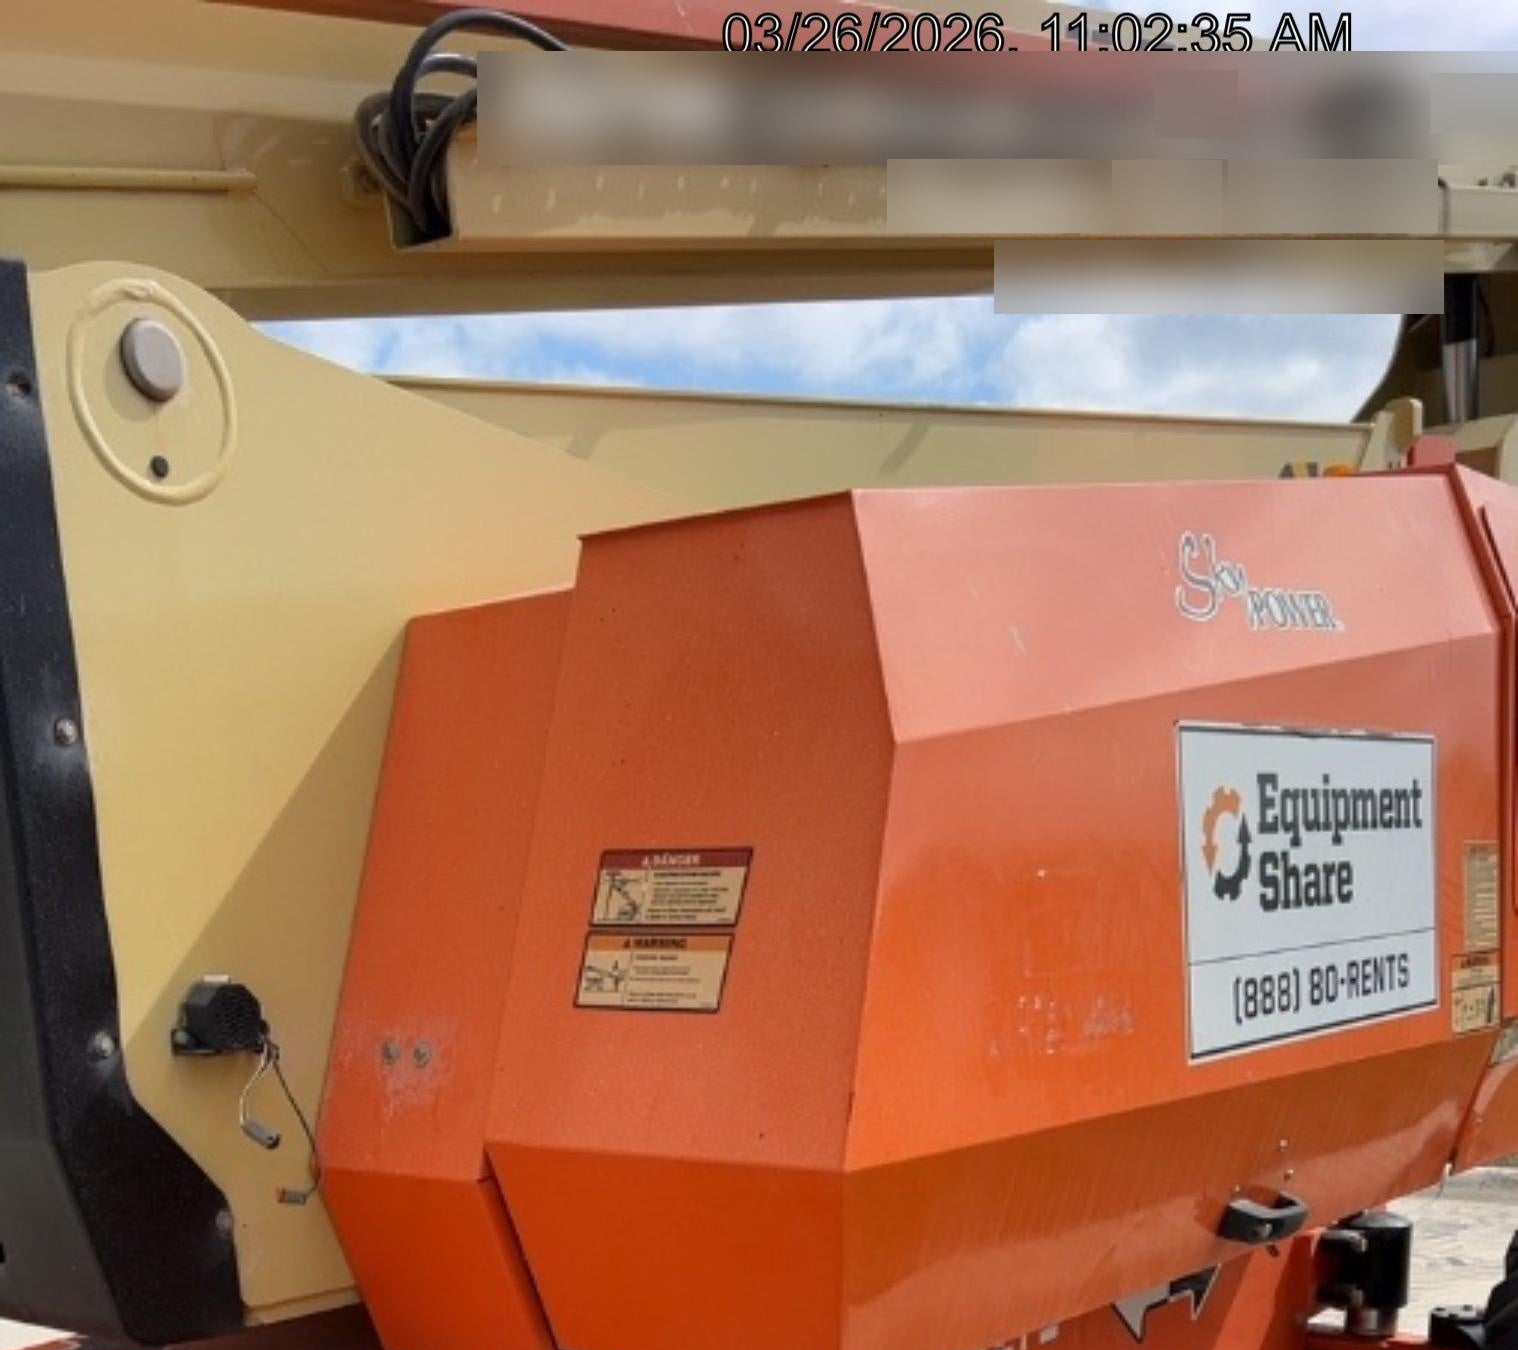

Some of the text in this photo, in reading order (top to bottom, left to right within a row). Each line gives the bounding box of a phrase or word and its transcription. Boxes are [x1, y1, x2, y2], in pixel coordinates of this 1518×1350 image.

[1257, 773, 1422, 847] Equipment
[1259, 850, 1353, 912] Share
[1232, 953, 1410, 1025] (888) 80-RENTS
